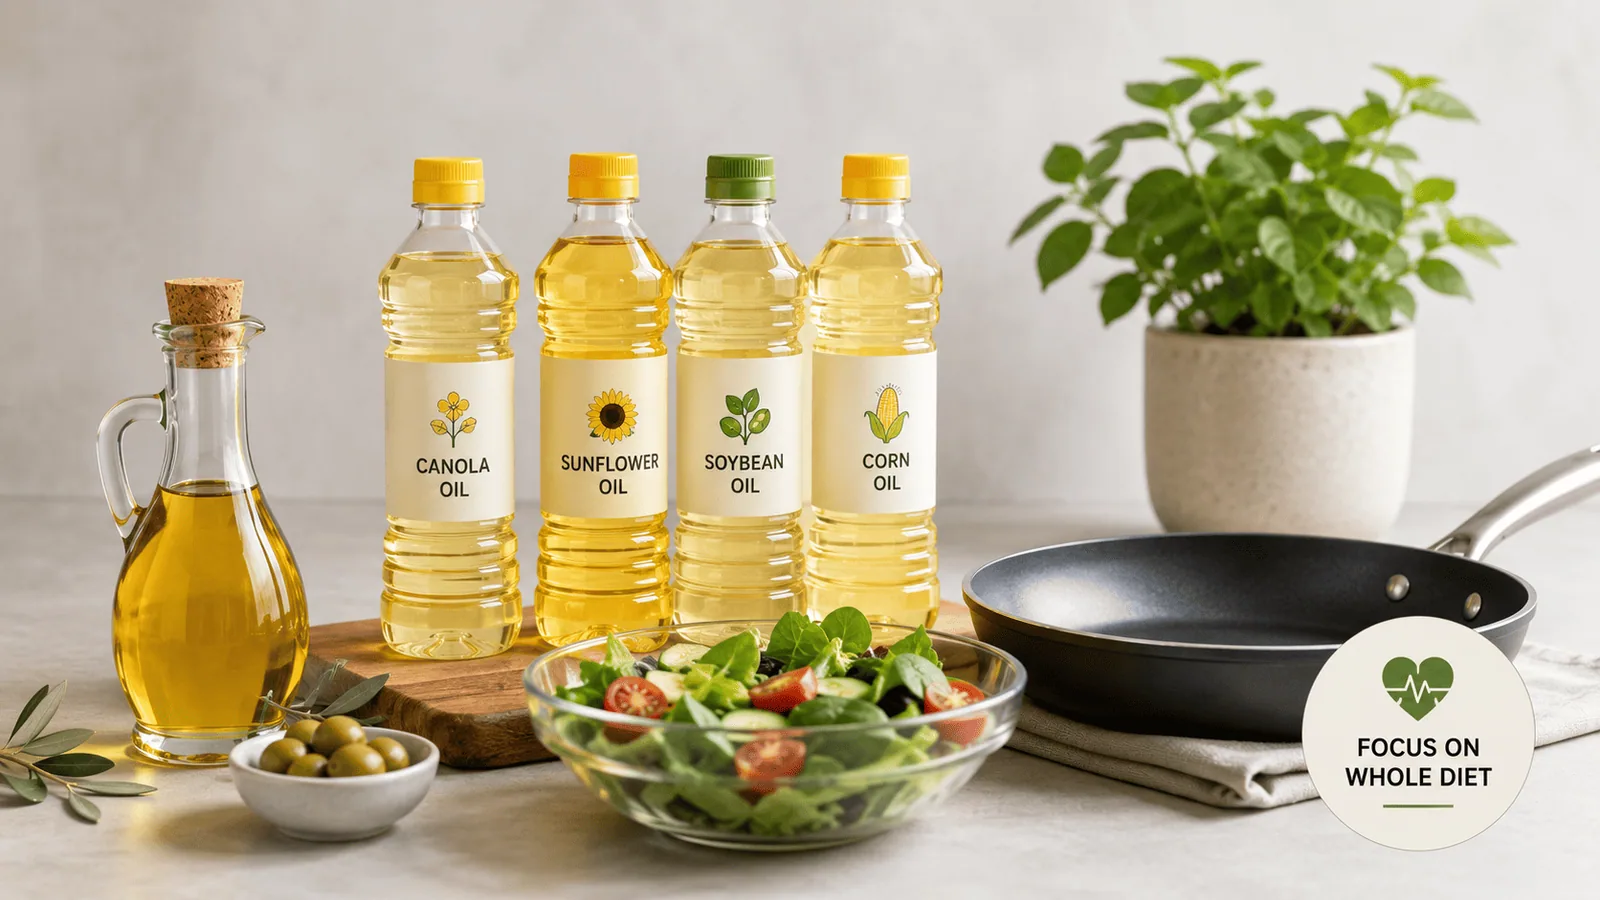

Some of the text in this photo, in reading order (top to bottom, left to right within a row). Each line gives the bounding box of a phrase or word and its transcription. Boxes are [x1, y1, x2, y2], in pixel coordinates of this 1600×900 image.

[416, 457, 490, 475] CANOLA
[561, 453, 659, 472] SUNFLOWER
[704, 453, 784, 471] SOYBEAN
[862, 452, 910, 469] CORN
[439, 481, 470, 498] OIL
[598, 478, 628, 495] OIL
[731, 477, 760, 494] OIL
[873, 475, 901, 491] OIL
